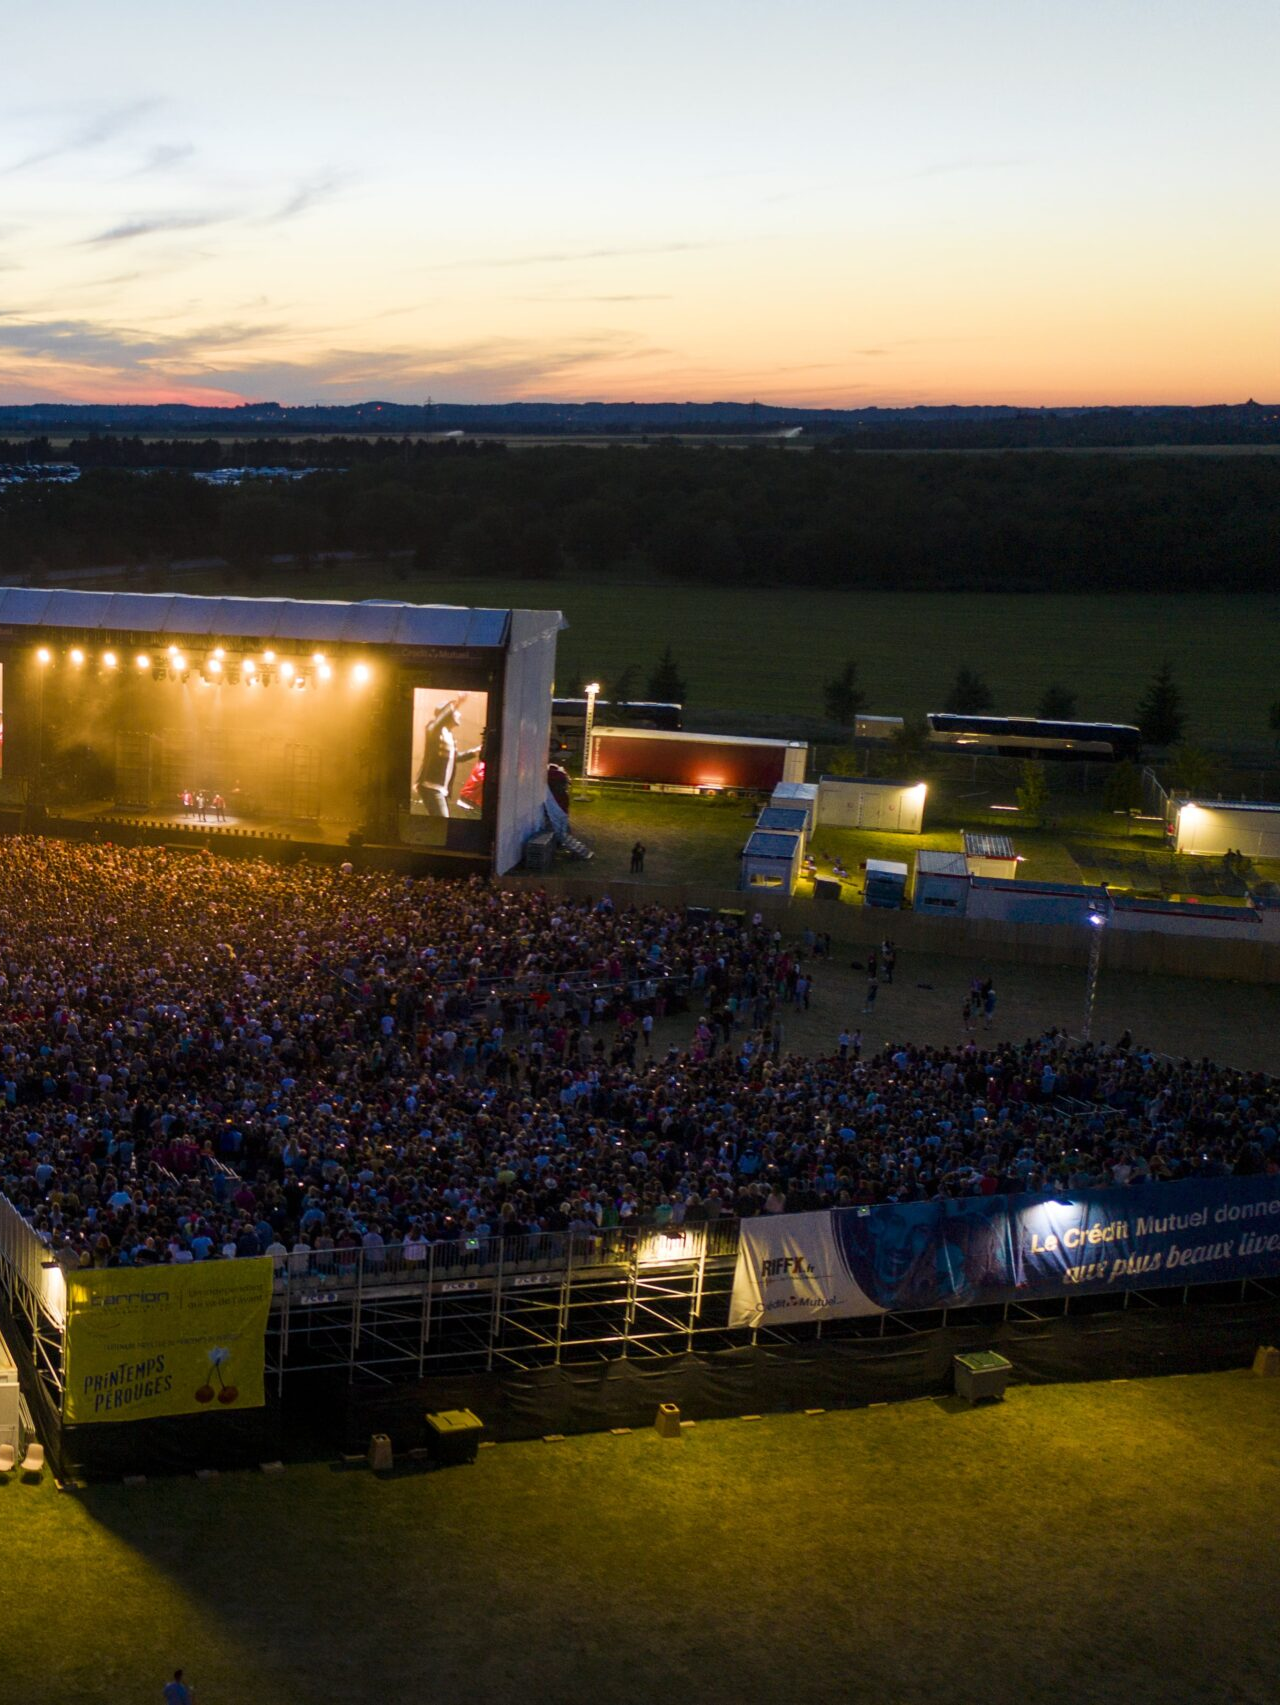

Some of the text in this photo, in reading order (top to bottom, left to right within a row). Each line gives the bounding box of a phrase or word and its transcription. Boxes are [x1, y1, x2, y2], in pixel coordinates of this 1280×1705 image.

[1030, 1199, 1280, 1255] Le Crédit Mutuel donne
[1062, 1259, 1108, 1284] aux
[1108, 1250, 1163, 1284] plus
[1165, 1244, 1234, 1269] beaux
[799, 1295, 837, 1308] Mutuel
